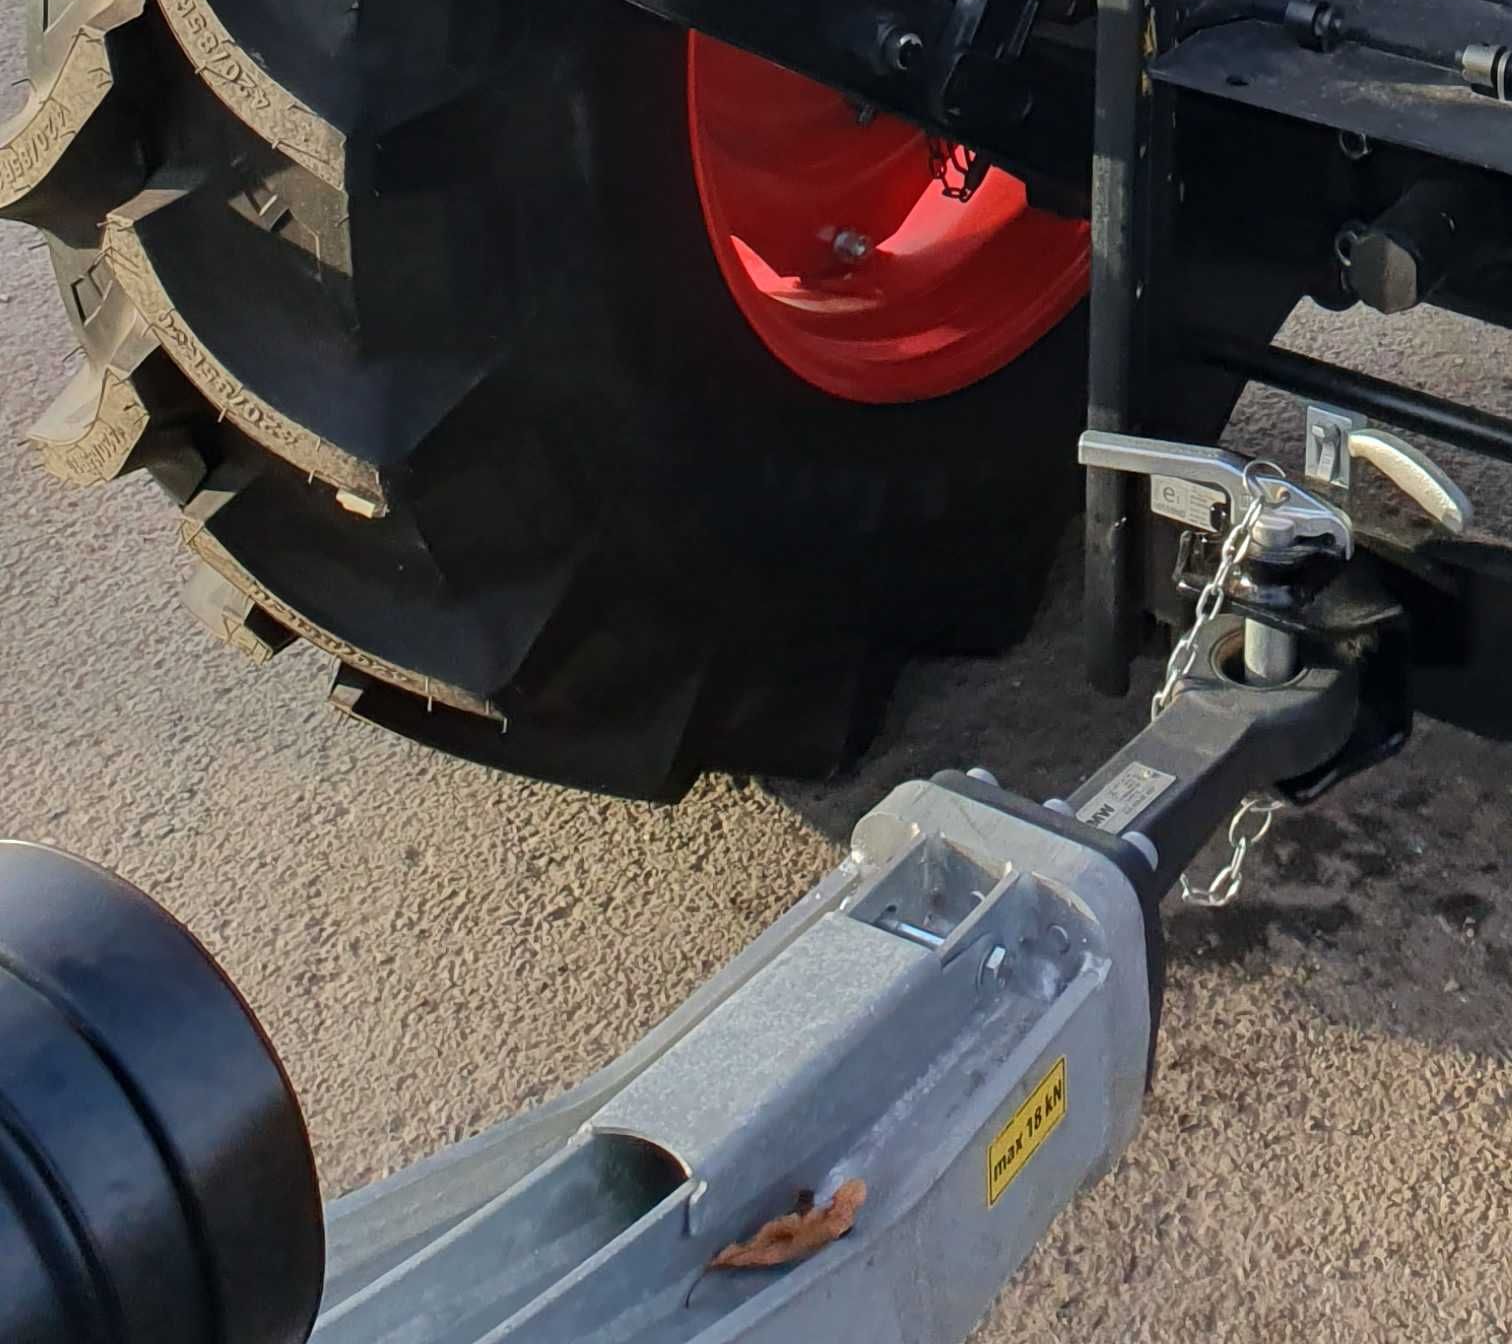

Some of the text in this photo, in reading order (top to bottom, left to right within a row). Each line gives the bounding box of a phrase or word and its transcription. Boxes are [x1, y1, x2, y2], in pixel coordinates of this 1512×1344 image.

[994, 1079, 1062, 1183] max 18 kN
